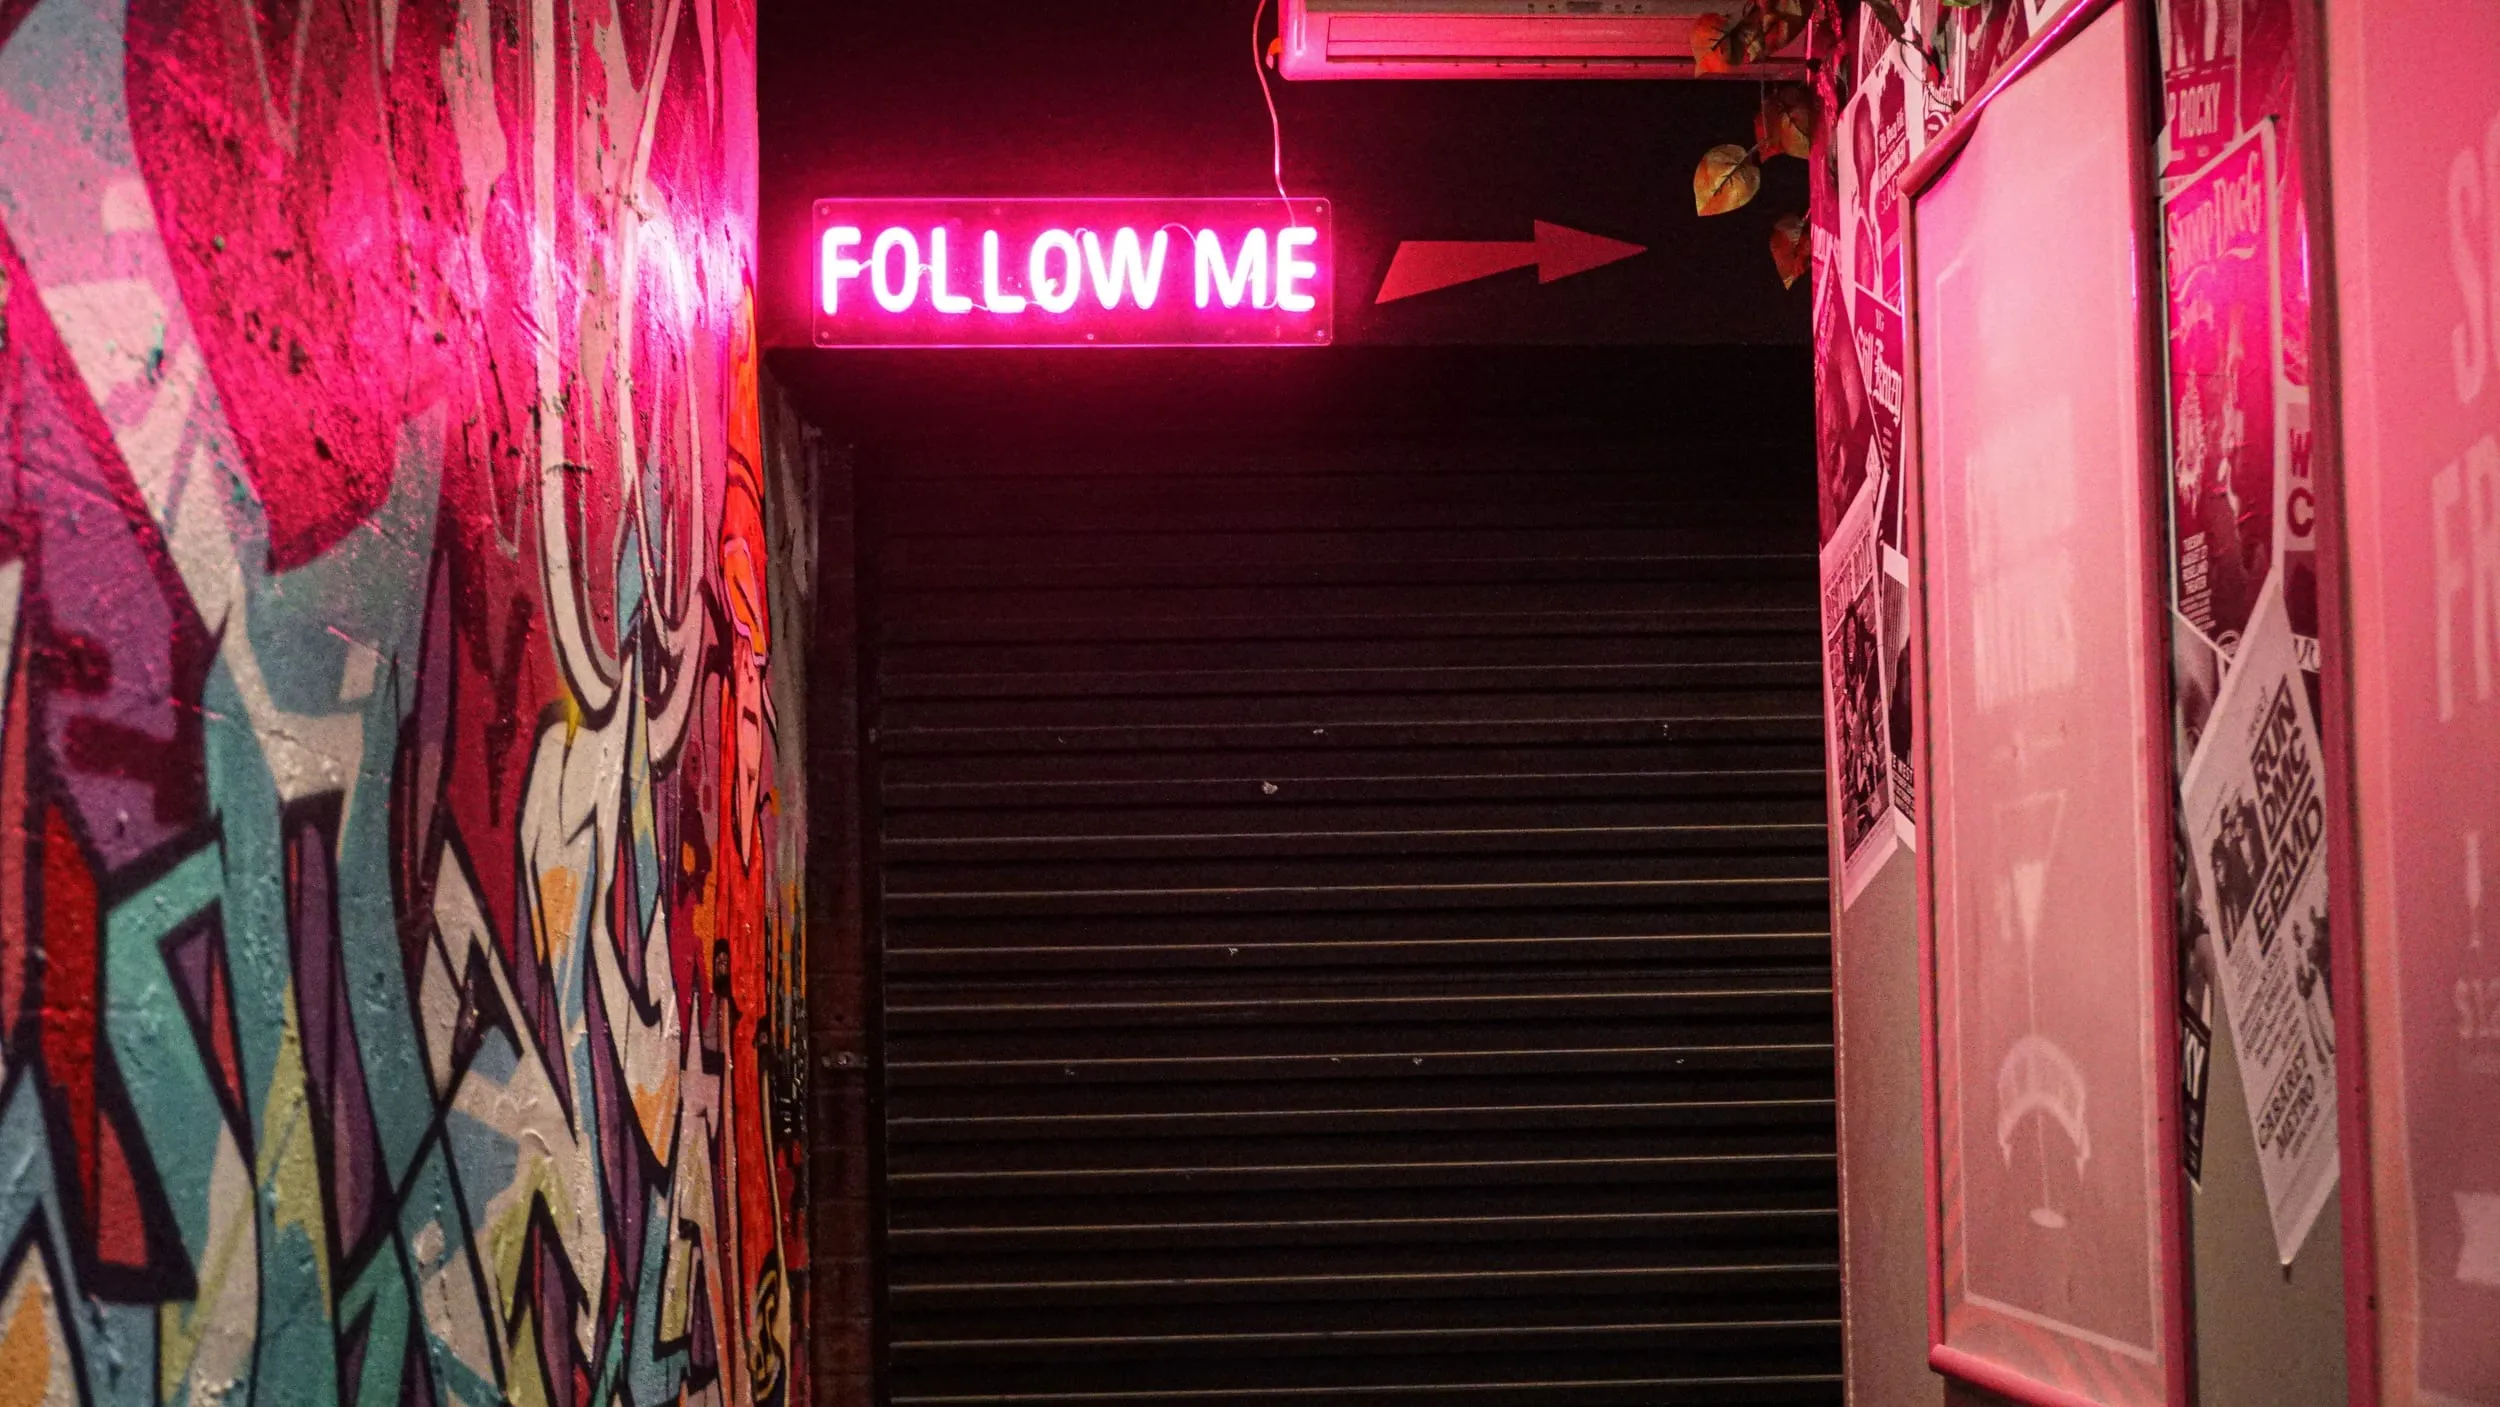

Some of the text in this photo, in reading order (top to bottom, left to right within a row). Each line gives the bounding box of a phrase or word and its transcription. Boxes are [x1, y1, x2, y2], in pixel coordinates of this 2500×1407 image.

[2179, 82, 2221, 139] ROCKY
[821, 226, 1318, 315] FOLLOW ME
[2253, 683, 2297, 798] RUN
[2261, 725, 2306, 840] DMC
[2252, 794, 2323, 946] EPMD
